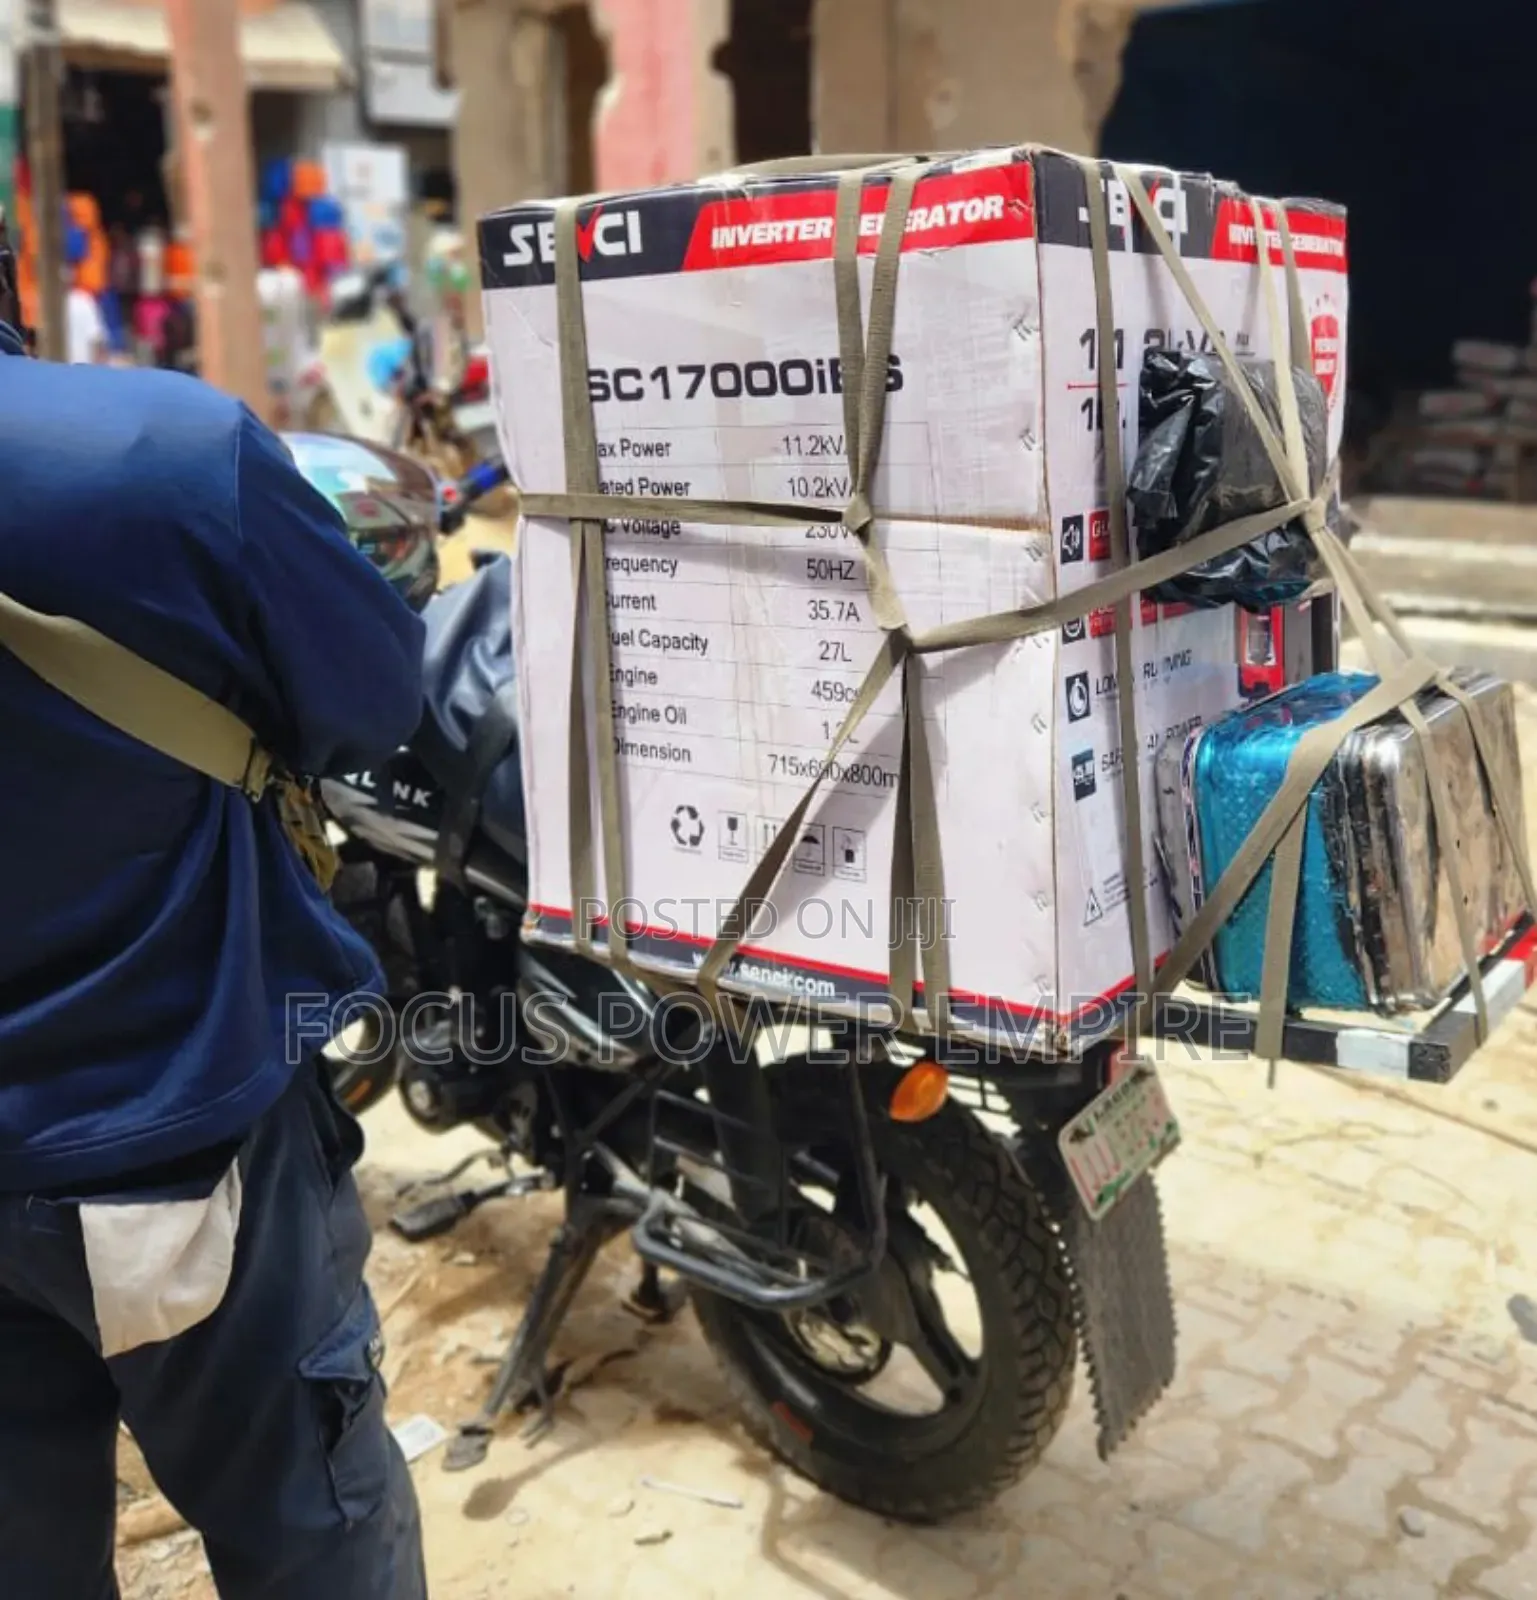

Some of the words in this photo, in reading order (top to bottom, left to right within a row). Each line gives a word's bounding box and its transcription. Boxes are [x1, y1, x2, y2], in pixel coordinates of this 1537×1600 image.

[711, 216, 833, 249] INVERTER
[598, 442, 617, 457] ax
[620, 438, 672, 457] Power
[782, 434, 848, 456] 11.2kV
[600, 479, 633, 495] ated
[638, 477, 691, 496] Power
[606, 557, 678, 578] requency
[806, 558, 858, 581] 50HZ
[610, 593, 657, 611] urrent
[807, 600, 860, 622] 35.7A
[611, 630, 634, 646] uel
[638, 629, 709, 656] Capacity
[818, 640, 853, 662] 27L
[664, 705, 687, 725] Oil
